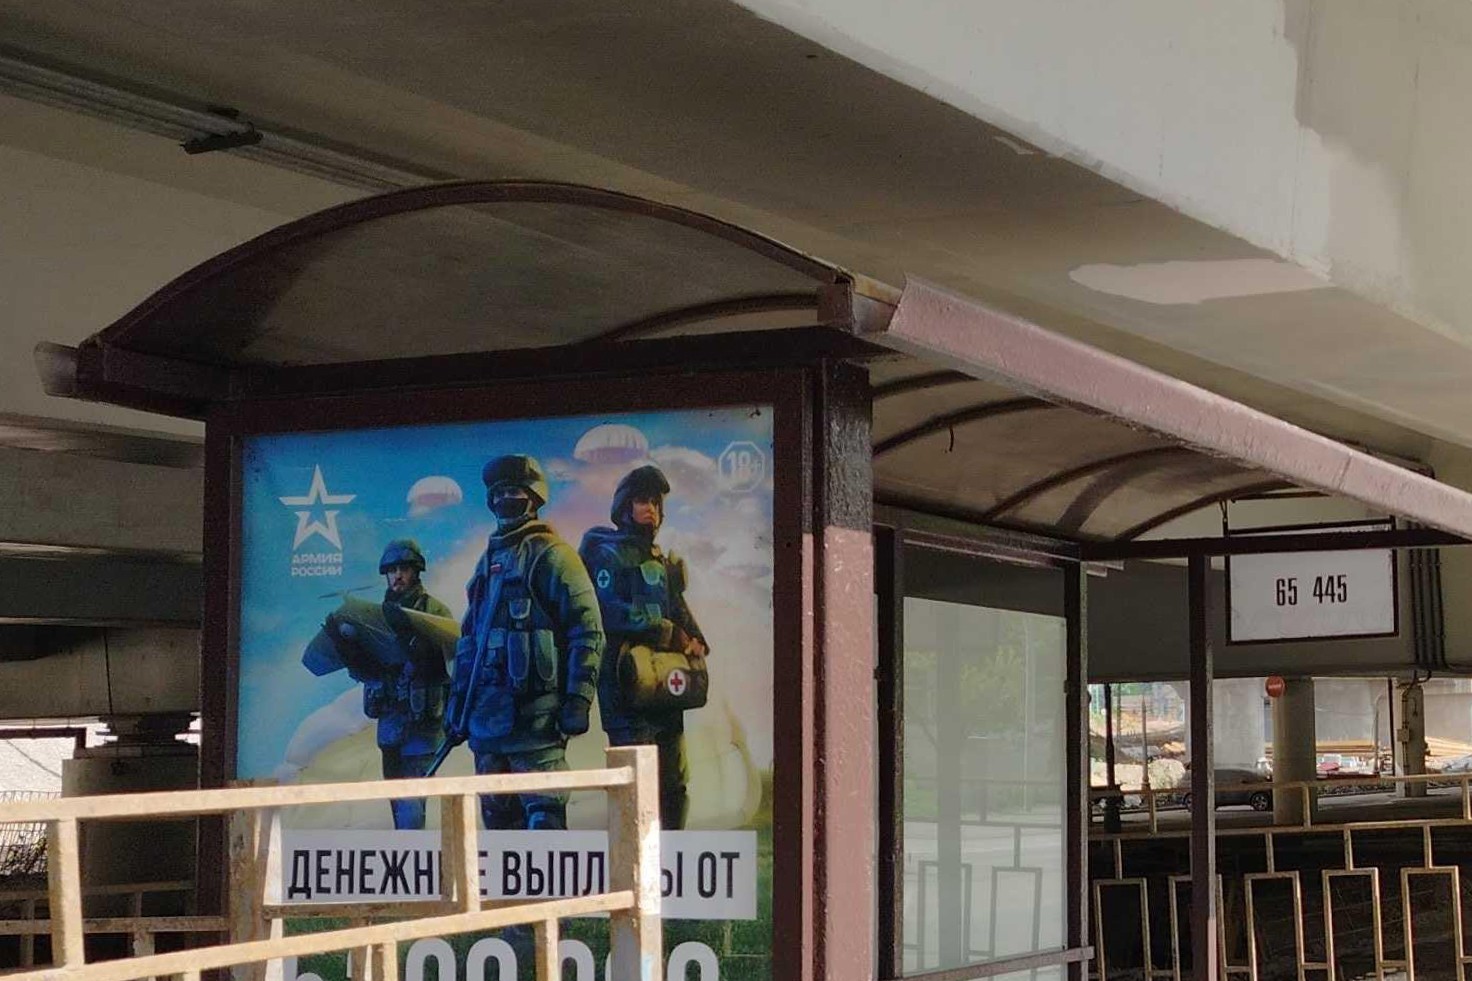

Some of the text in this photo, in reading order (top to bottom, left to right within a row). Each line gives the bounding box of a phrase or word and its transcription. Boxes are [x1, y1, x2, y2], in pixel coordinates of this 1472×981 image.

[293, 553, 342, 564] АРМИЯ
[291, 566, 342, 576] РОССИИ
[1276, 574, 1348, 606] 65 445
[288, 850, 740, 899] ДЕНЕЖНЕ ВЫПЛЫ ОТ
